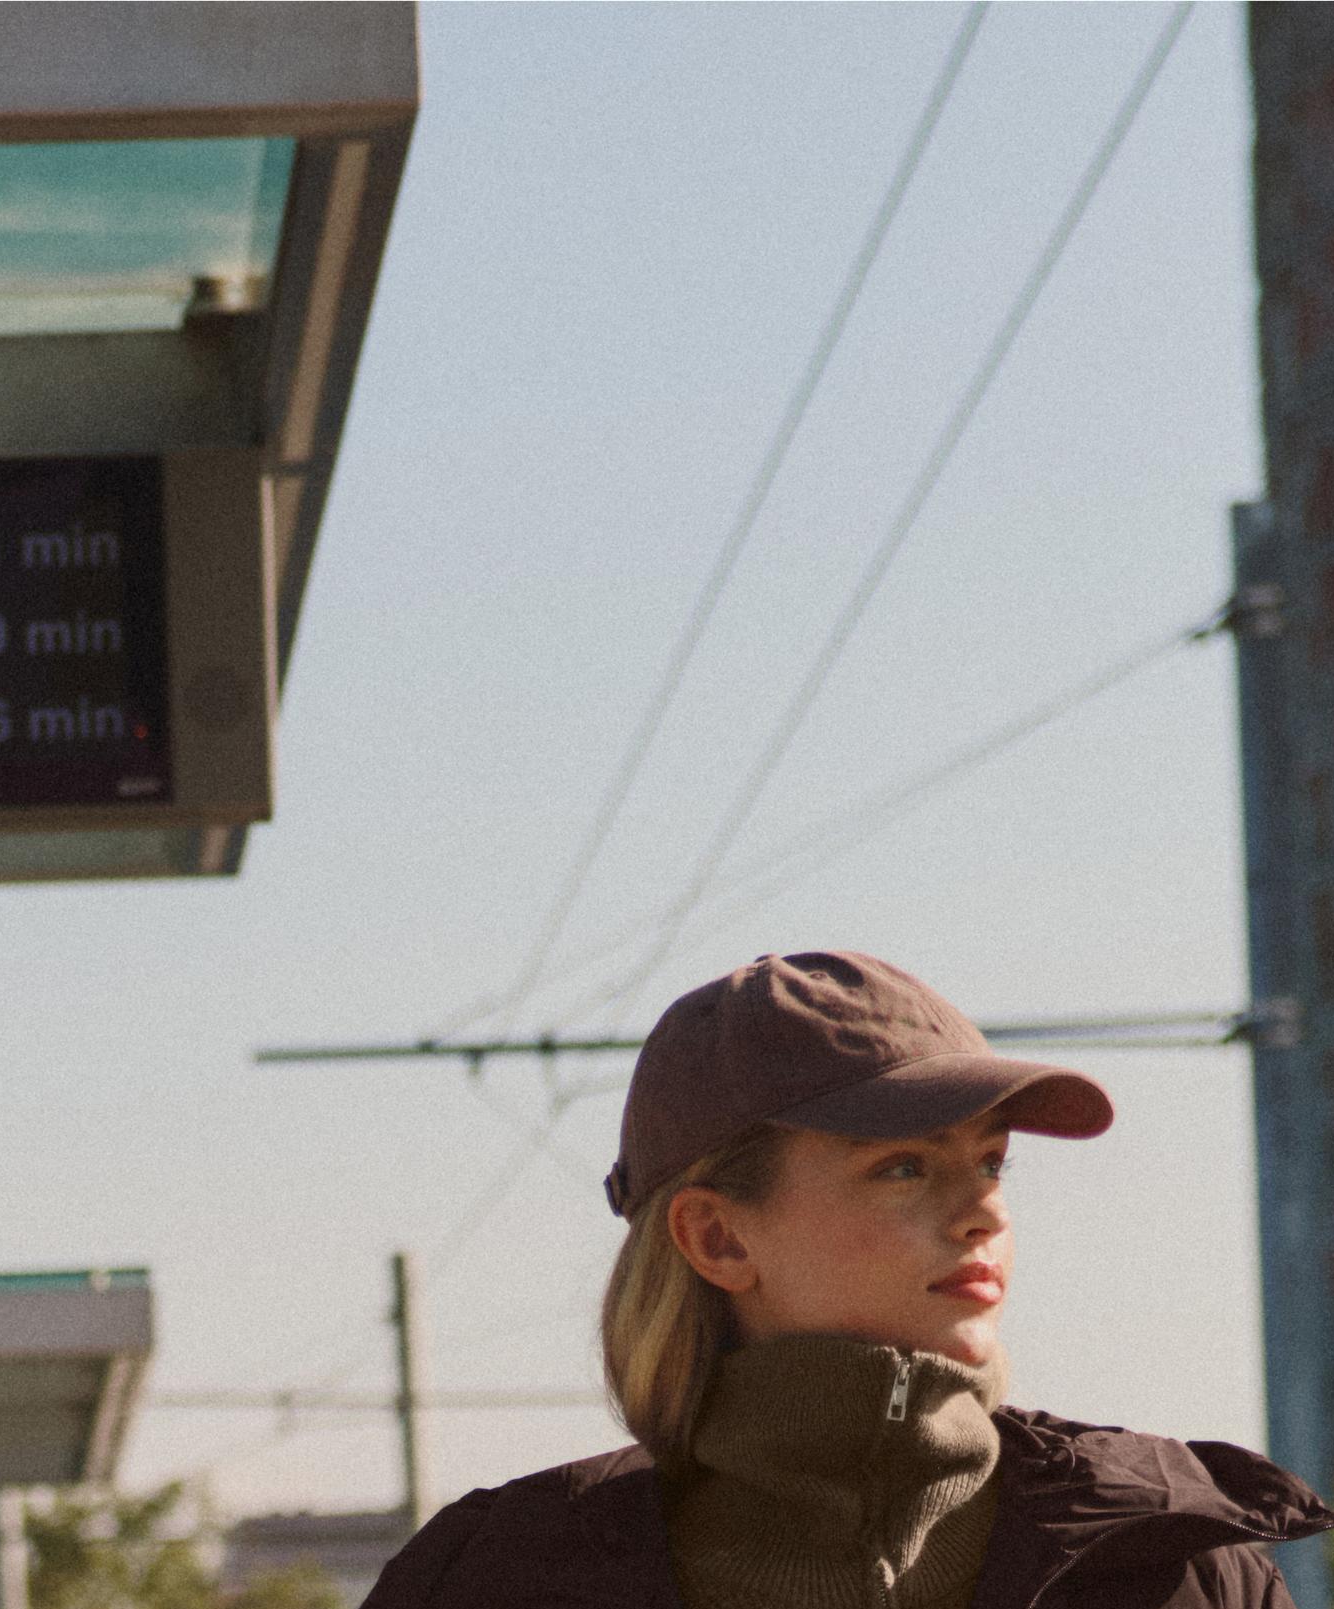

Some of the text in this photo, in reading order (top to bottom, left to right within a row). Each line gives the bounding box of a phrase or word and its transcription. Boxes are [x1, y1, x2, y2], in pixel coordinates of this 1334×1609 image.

[21, 521, 121, 569] min
[25, 607, 123, 656] min
[28, 693, 125, 743] min
